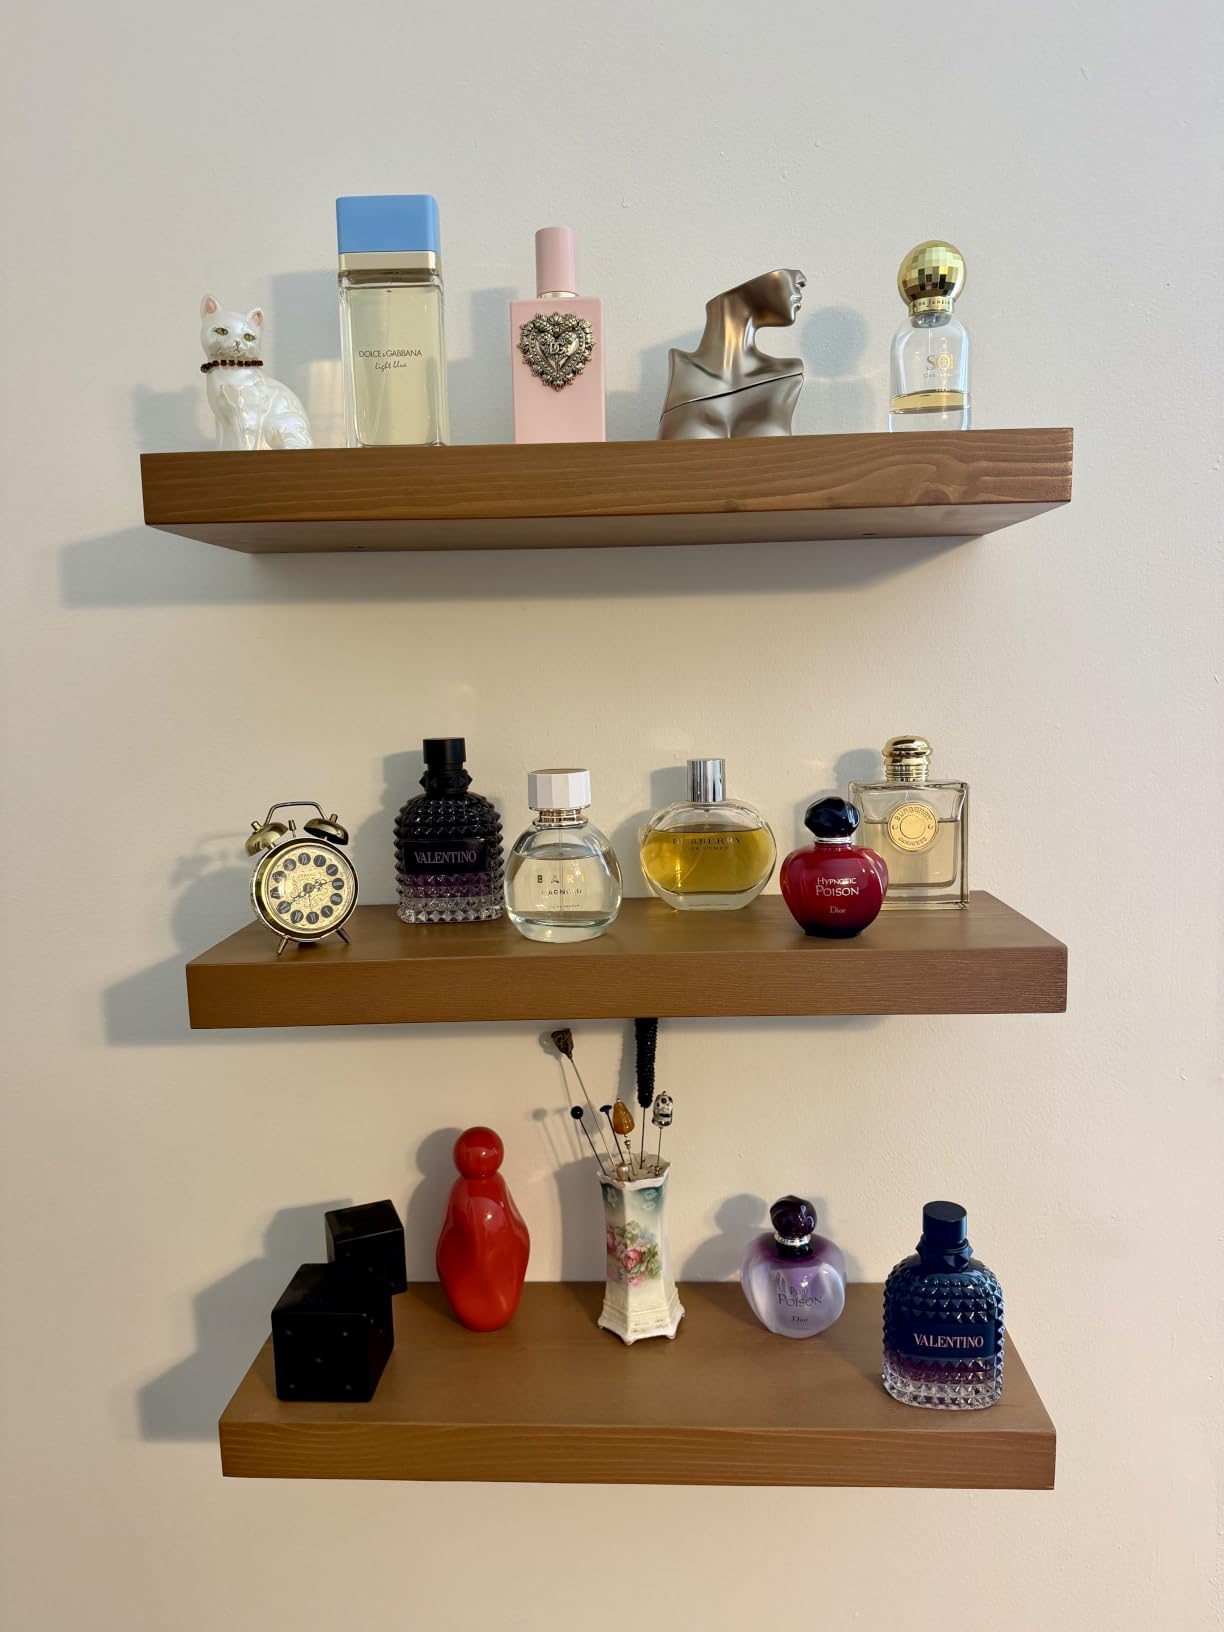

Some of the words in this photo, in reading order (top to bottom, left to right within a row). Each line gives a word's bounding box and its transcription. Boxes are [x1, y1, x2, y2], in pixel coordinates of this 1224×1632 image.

[374, 361, 391, 372] light
[393, 360, 407, 369] blue
[414, 851, 477, 864] VALENTINO
[913, 1333, 985, 1348] VALENTINO
